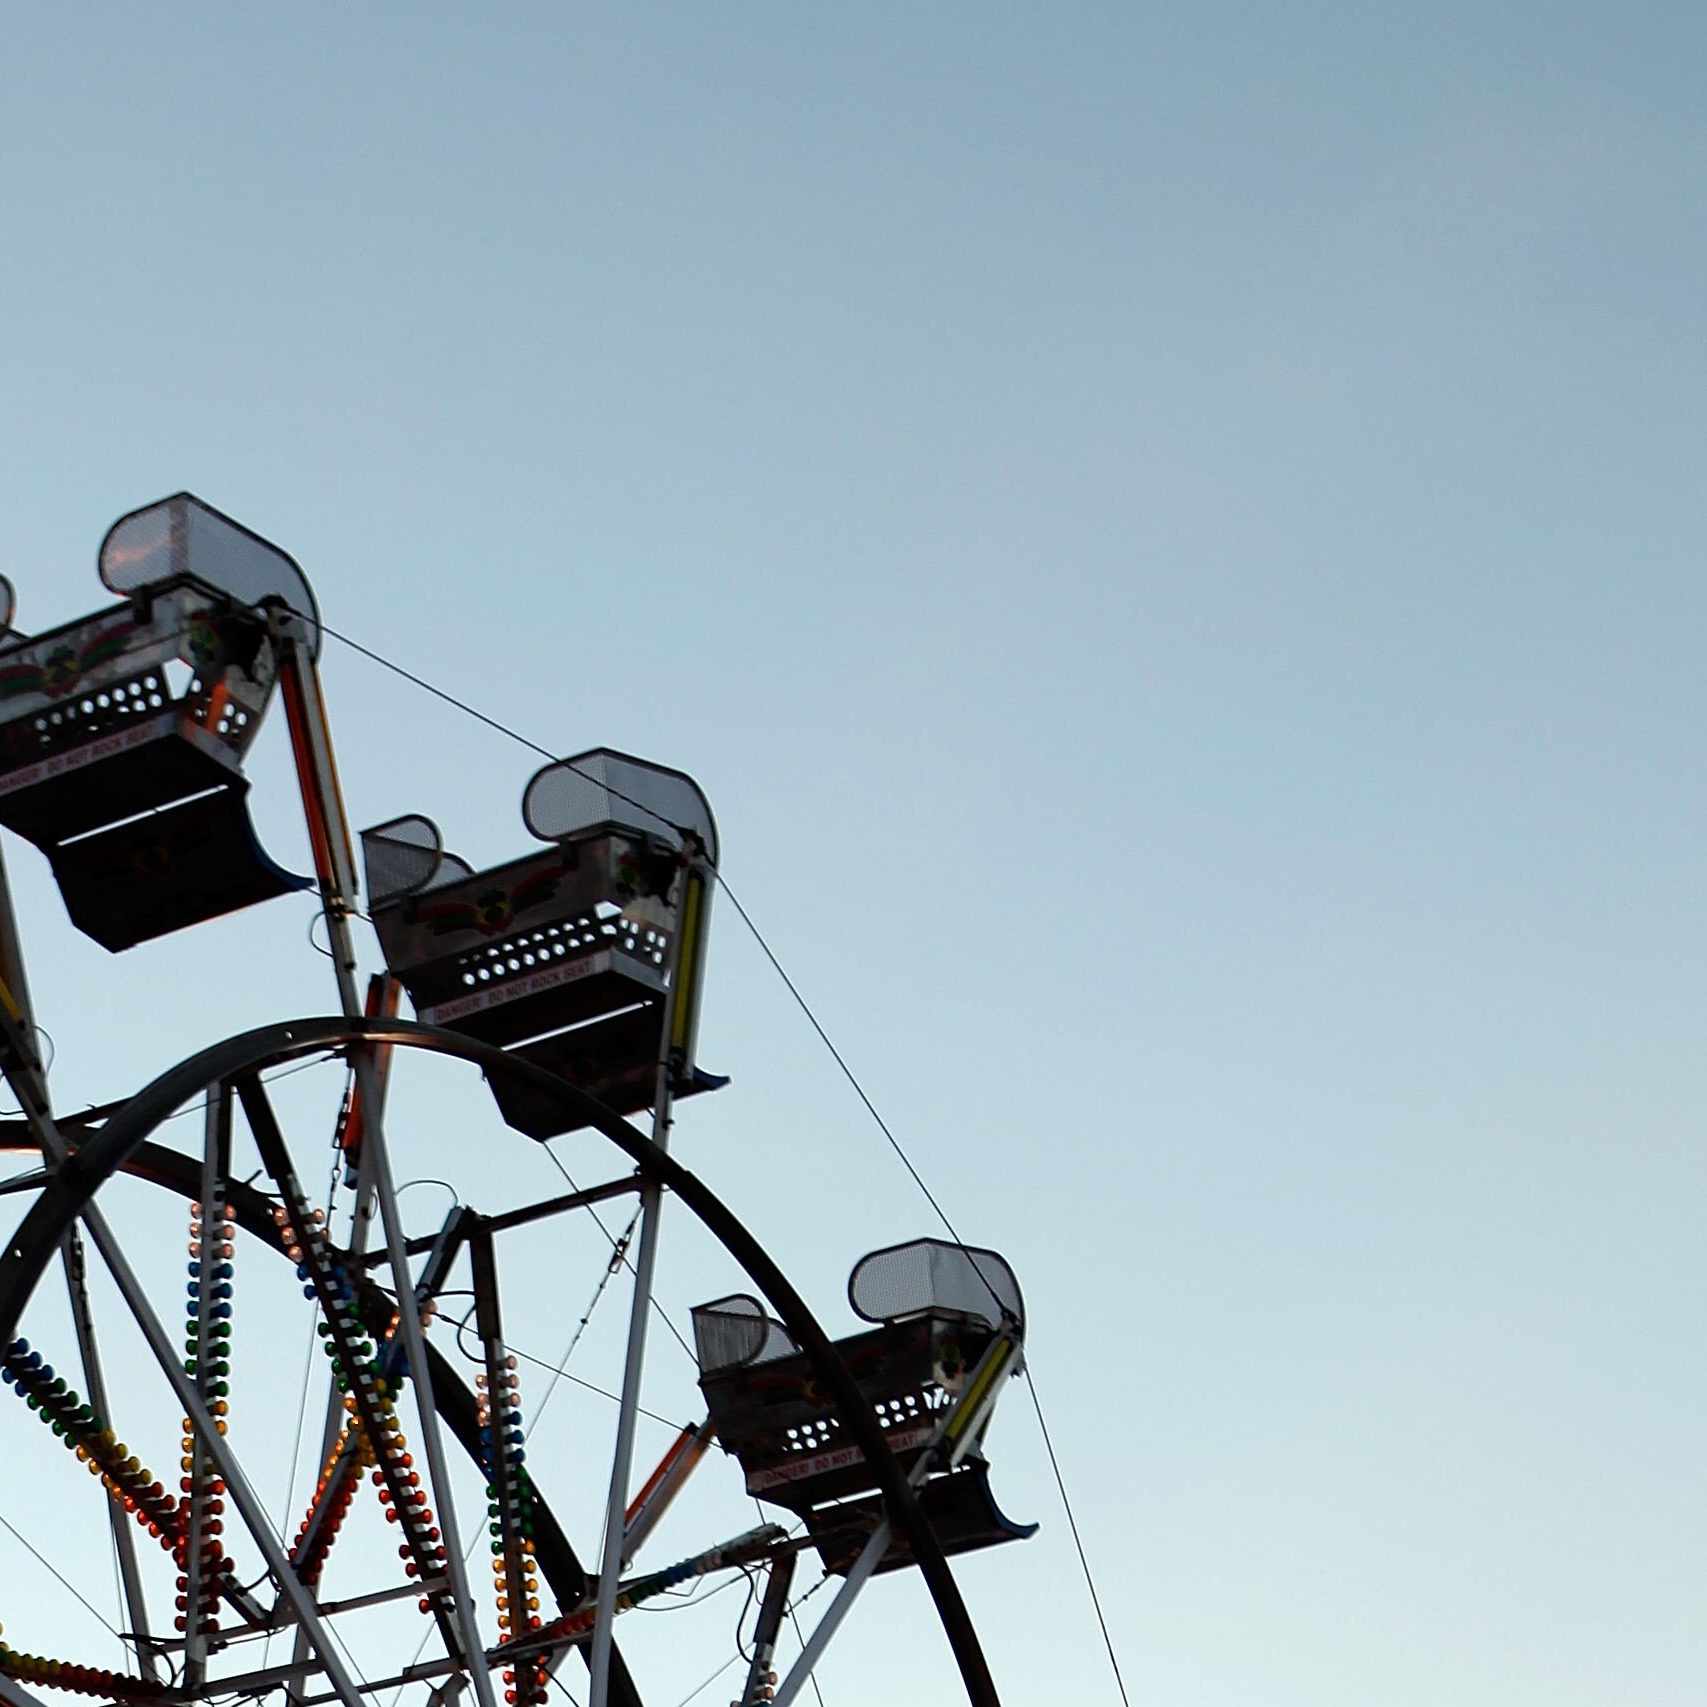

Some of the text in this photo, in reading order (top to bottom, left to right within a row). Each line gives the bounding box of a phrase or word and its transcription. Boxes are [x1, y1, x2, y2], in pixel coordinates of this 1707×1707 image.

[506, 981, 527, 996] NOT
[563, 960, 591, 979] SEAT
[815, 1458, 829, 1471] DO
[832, 1450, 854, 1466] NOT
